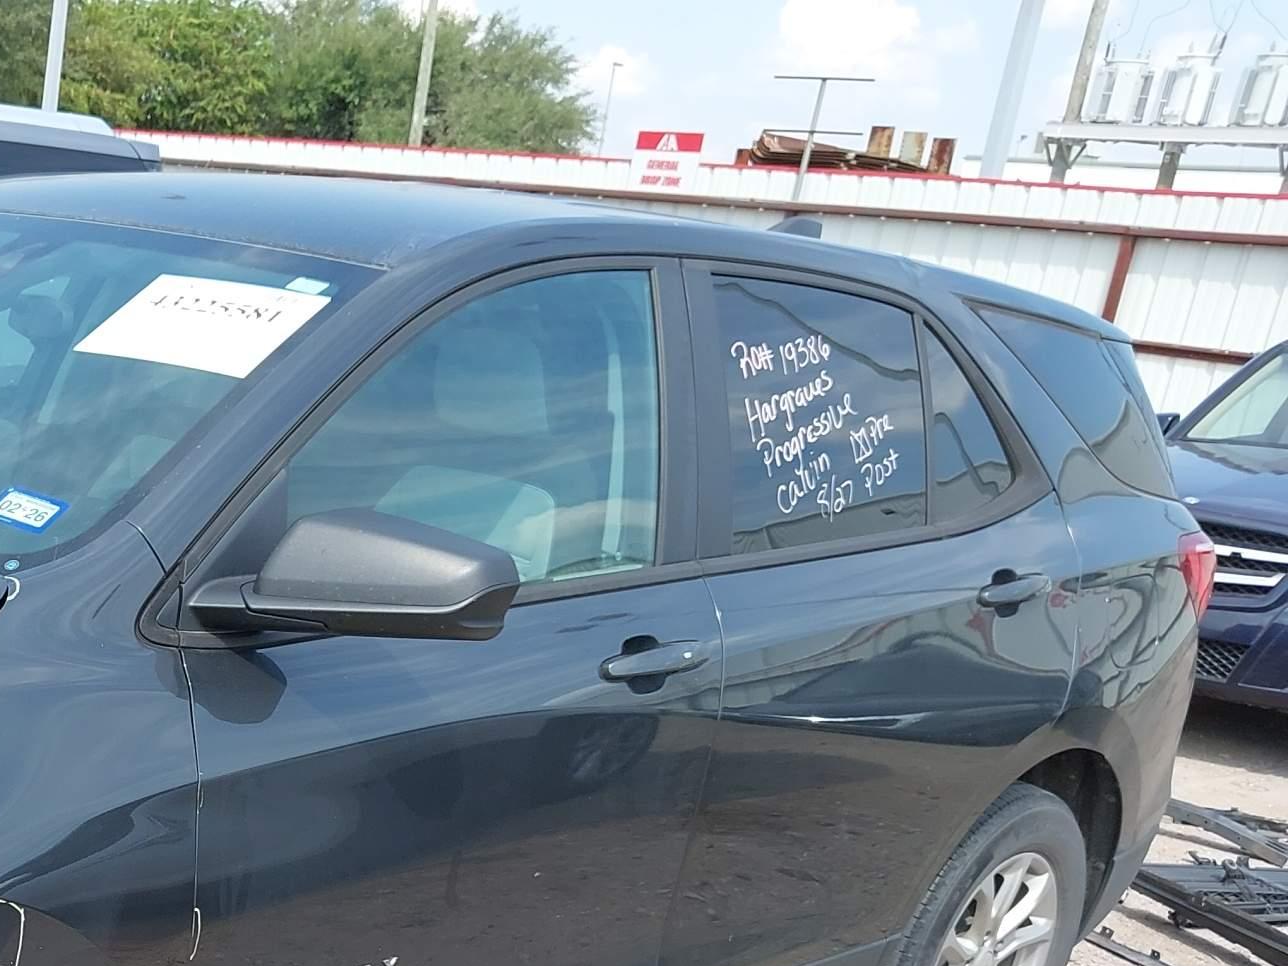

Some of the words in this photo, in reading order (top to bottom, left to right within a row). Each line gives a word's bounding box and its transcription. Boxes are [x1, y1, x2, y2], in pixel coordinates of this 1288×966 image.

[778, 335, 831, 375] 19386
[756, 392, 858, 478] Progressive
[816, 474, 854, 522] 8/27
[860, 448, 901, 497] Post
